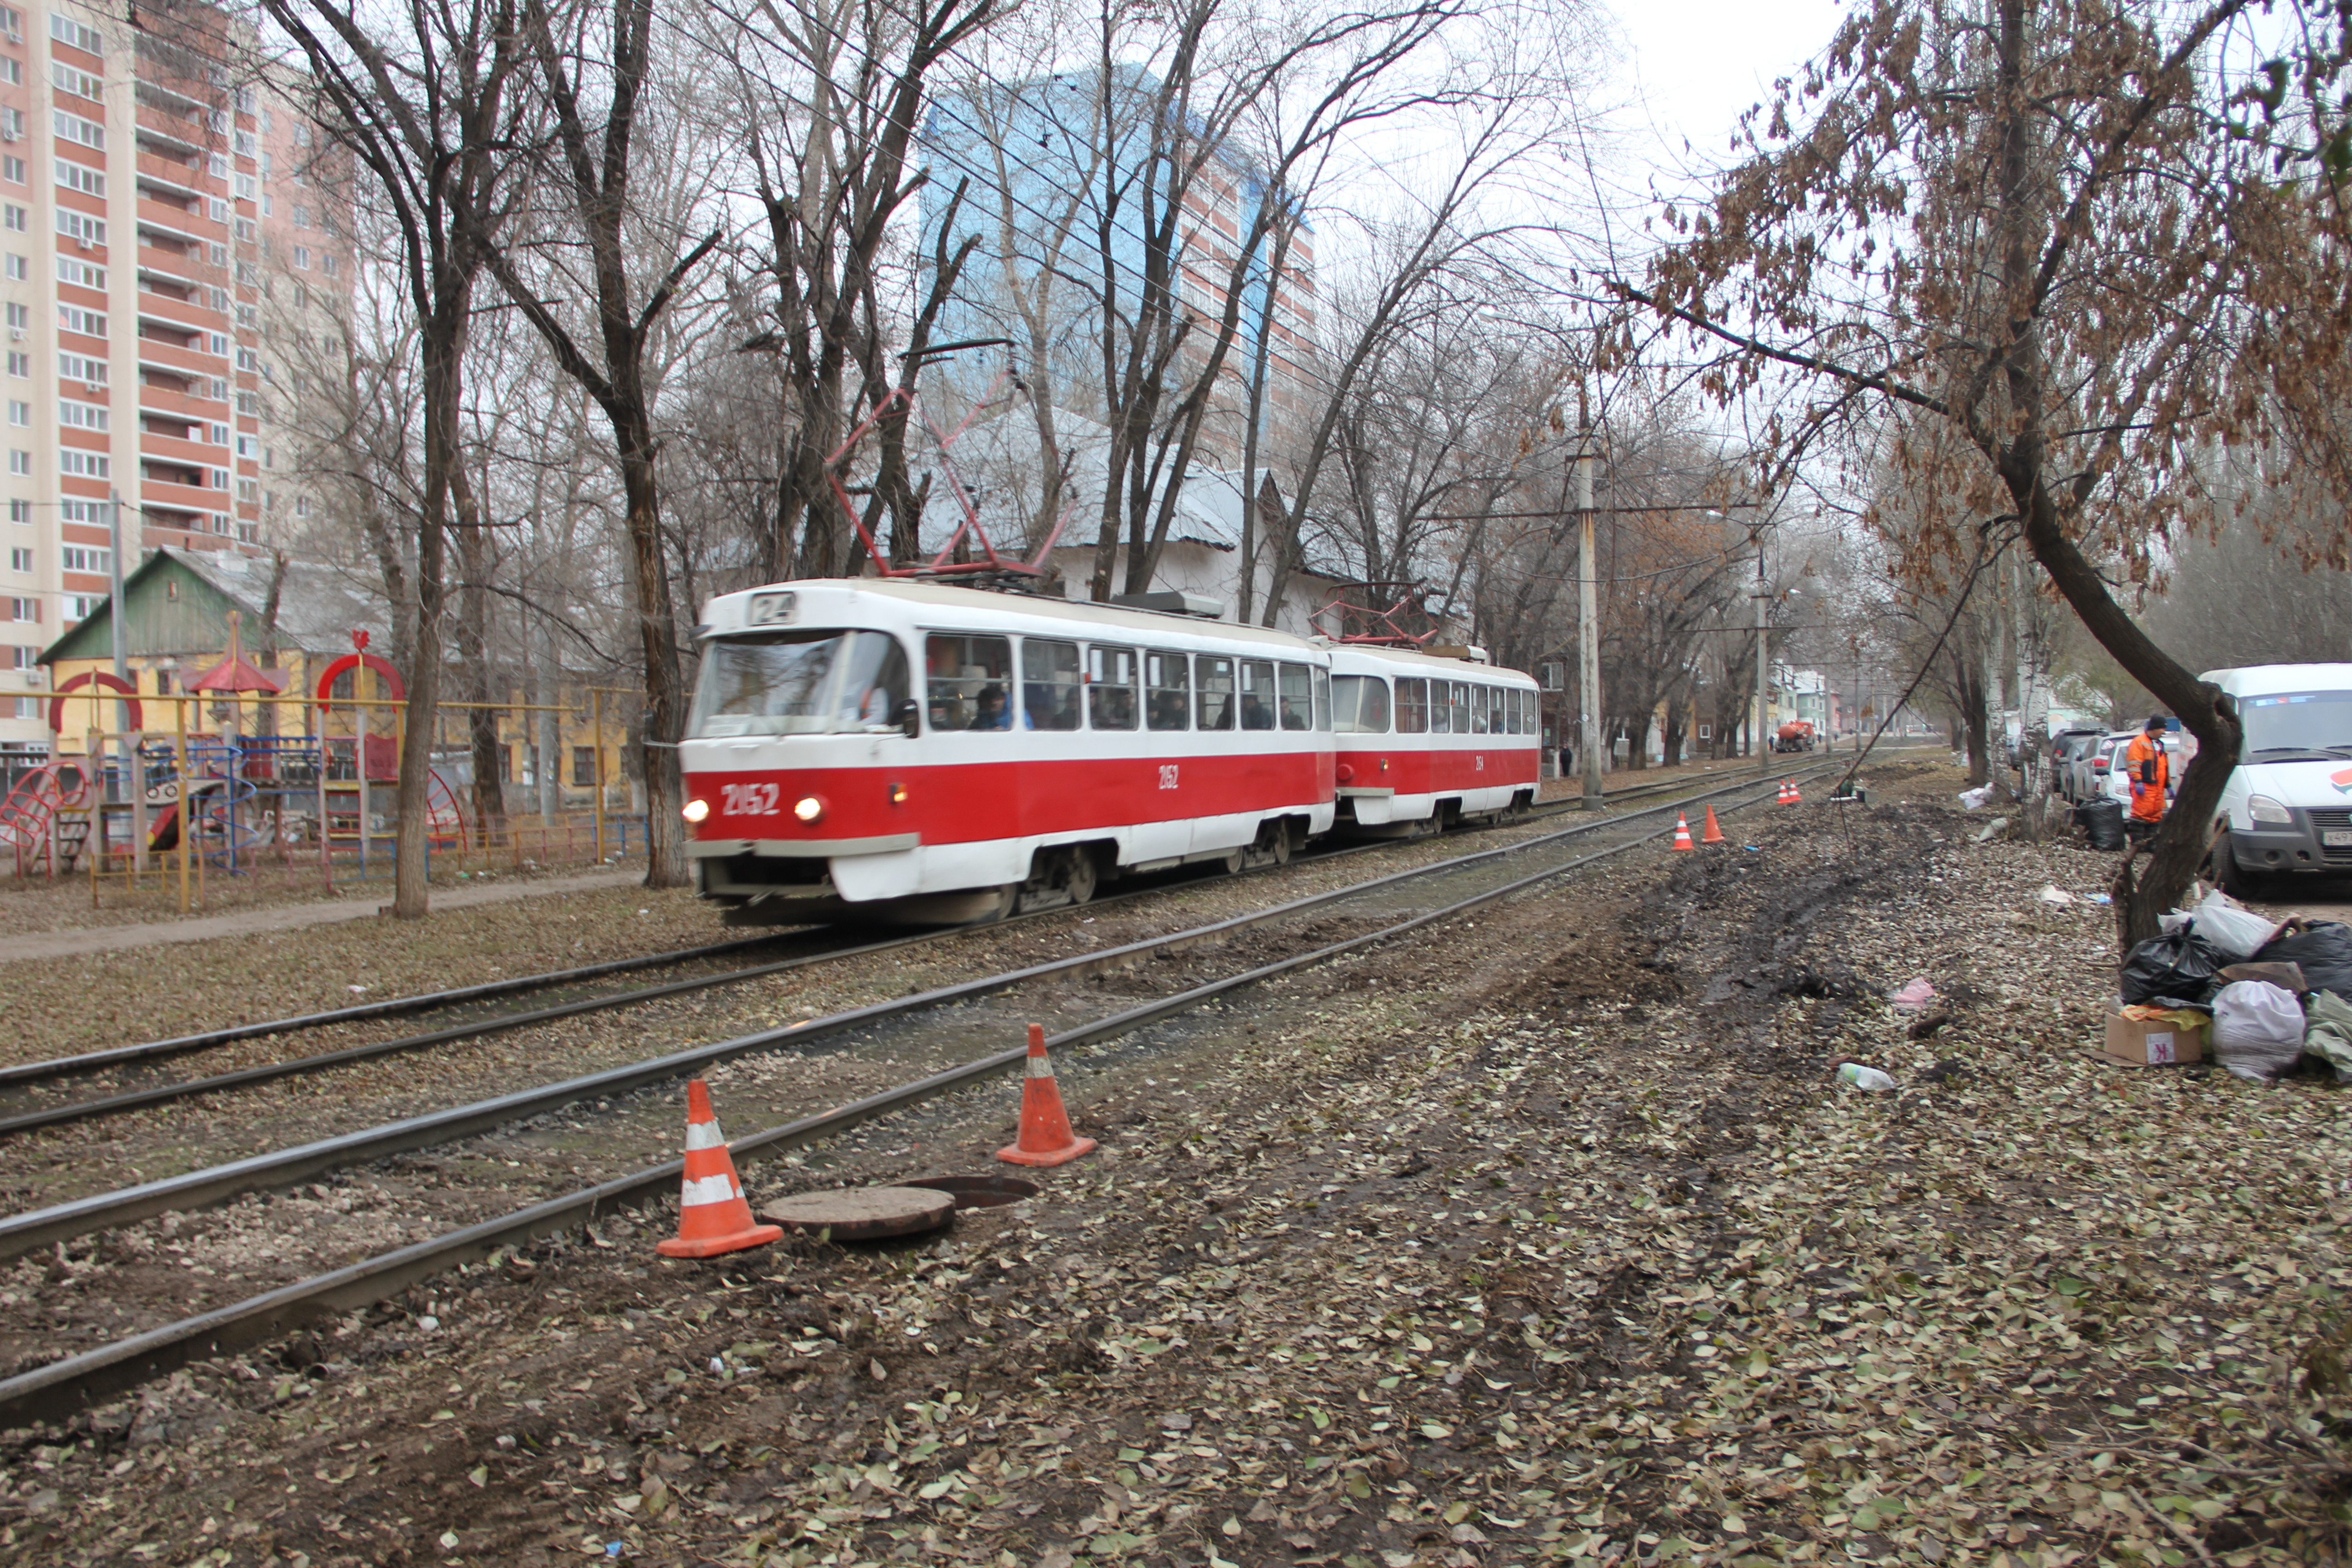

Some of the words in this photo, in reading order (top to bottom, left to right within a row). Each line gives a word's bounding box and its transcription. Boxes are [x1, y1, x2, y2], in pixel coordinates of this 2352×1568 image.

[756, 596, 796, 622] 24
[1159, 764, 1179, 789] 2152
[721, 783, 780, 815] 2152
